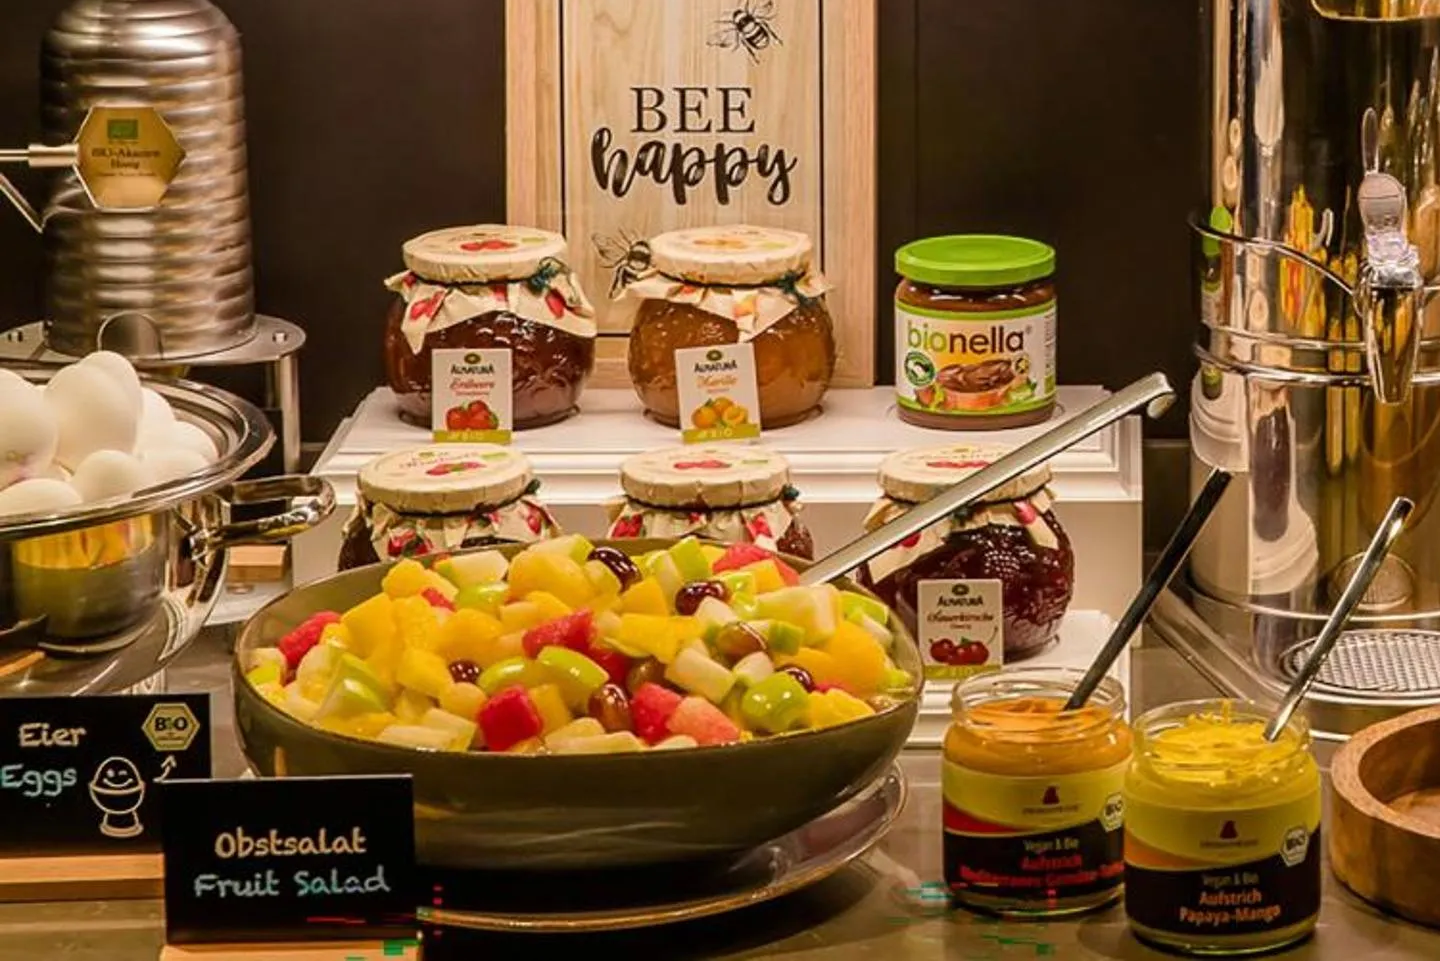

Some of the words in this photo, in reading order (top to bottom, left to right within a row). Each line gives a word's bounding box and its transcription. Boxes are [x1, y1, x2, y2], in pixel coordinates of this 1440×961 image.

[630, 87, 755, 133] BEE
[591, 127, 798, 205] happy
[907, 320, 1025, 355] bionella
[19, 722, 87, 747] Eier
[154, 716, 188, 732] BIO
[0, 763, 78, 797] Eggs
[214, 826, 368, 858] Obstsalat
[194, 869, 280, 898] Fruit
[294, 864, 391, 897] Salad
[1199, 887, 1262, 906] Aufstrich
[1180, 905, 1281, 927] Papaya-Mango
